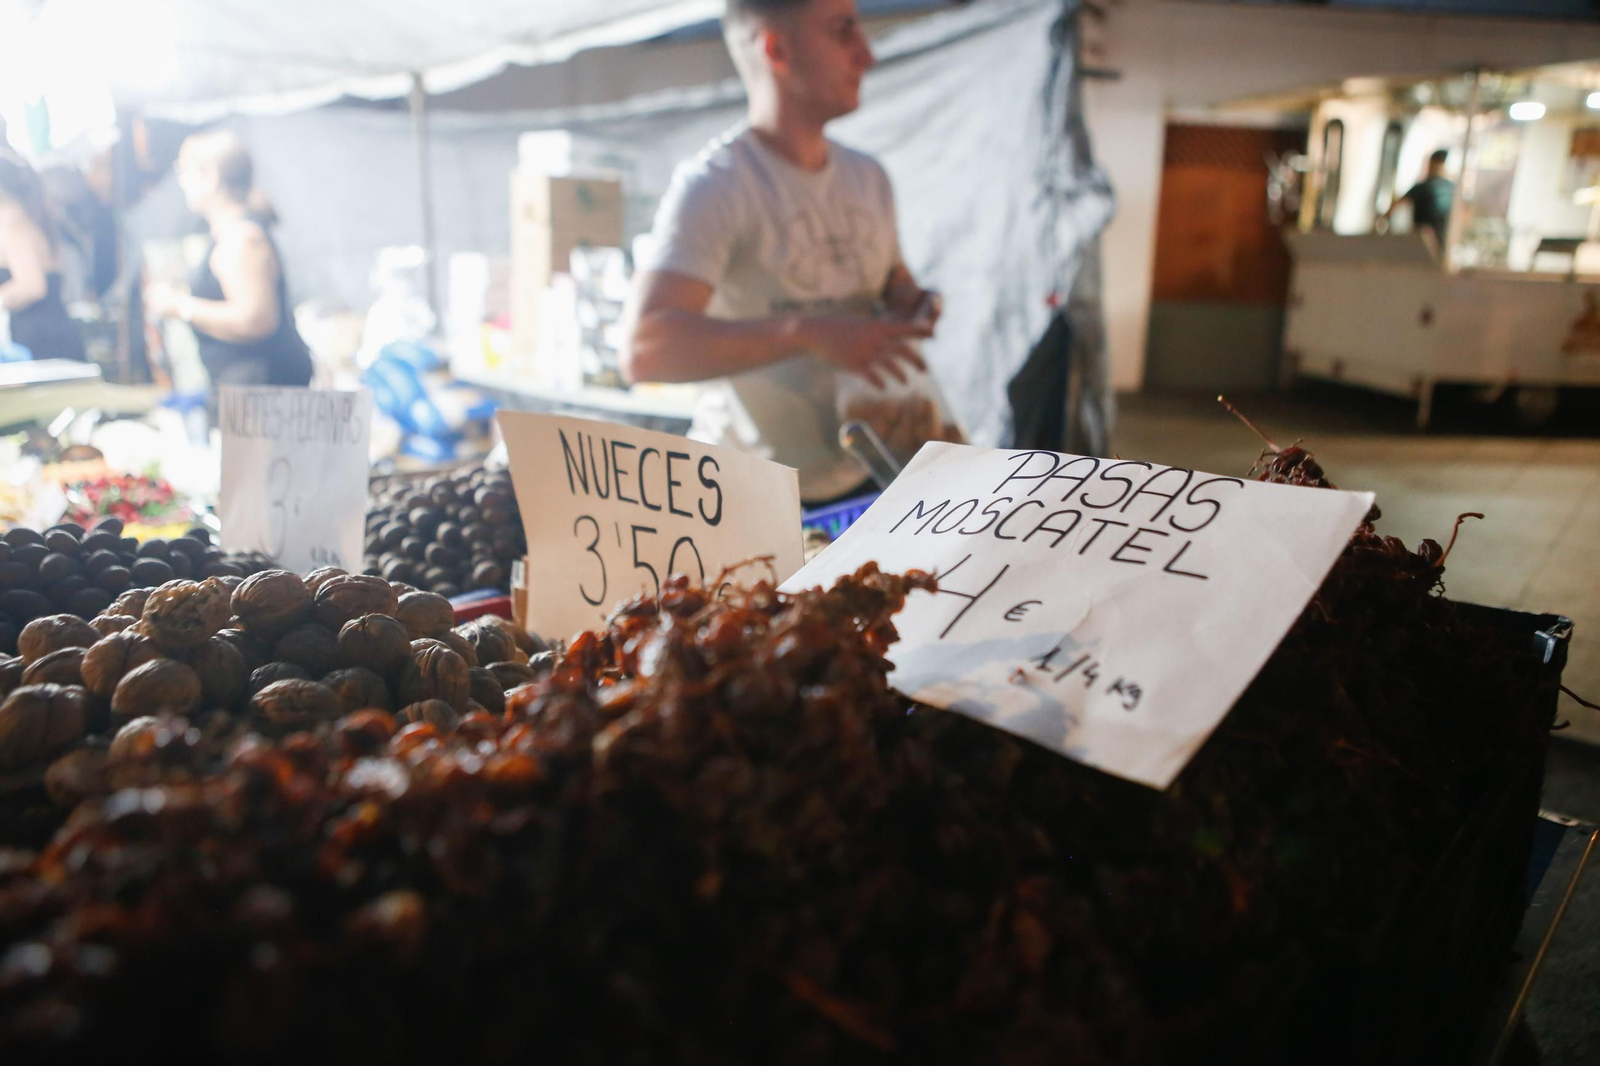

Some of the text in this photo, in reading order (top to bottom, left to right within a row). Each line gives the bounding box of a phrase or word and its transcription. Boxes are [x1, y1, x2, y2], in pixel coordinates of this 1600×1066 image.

[558, 428, 723, 527] NUECES
[993, 450, 1244, 532] PASAS
[889, 497, 1209, 580] MOSCATEL
[936, 553, 1042, 639] 4 €
[1030, 646, 1099, 689] 1/4
